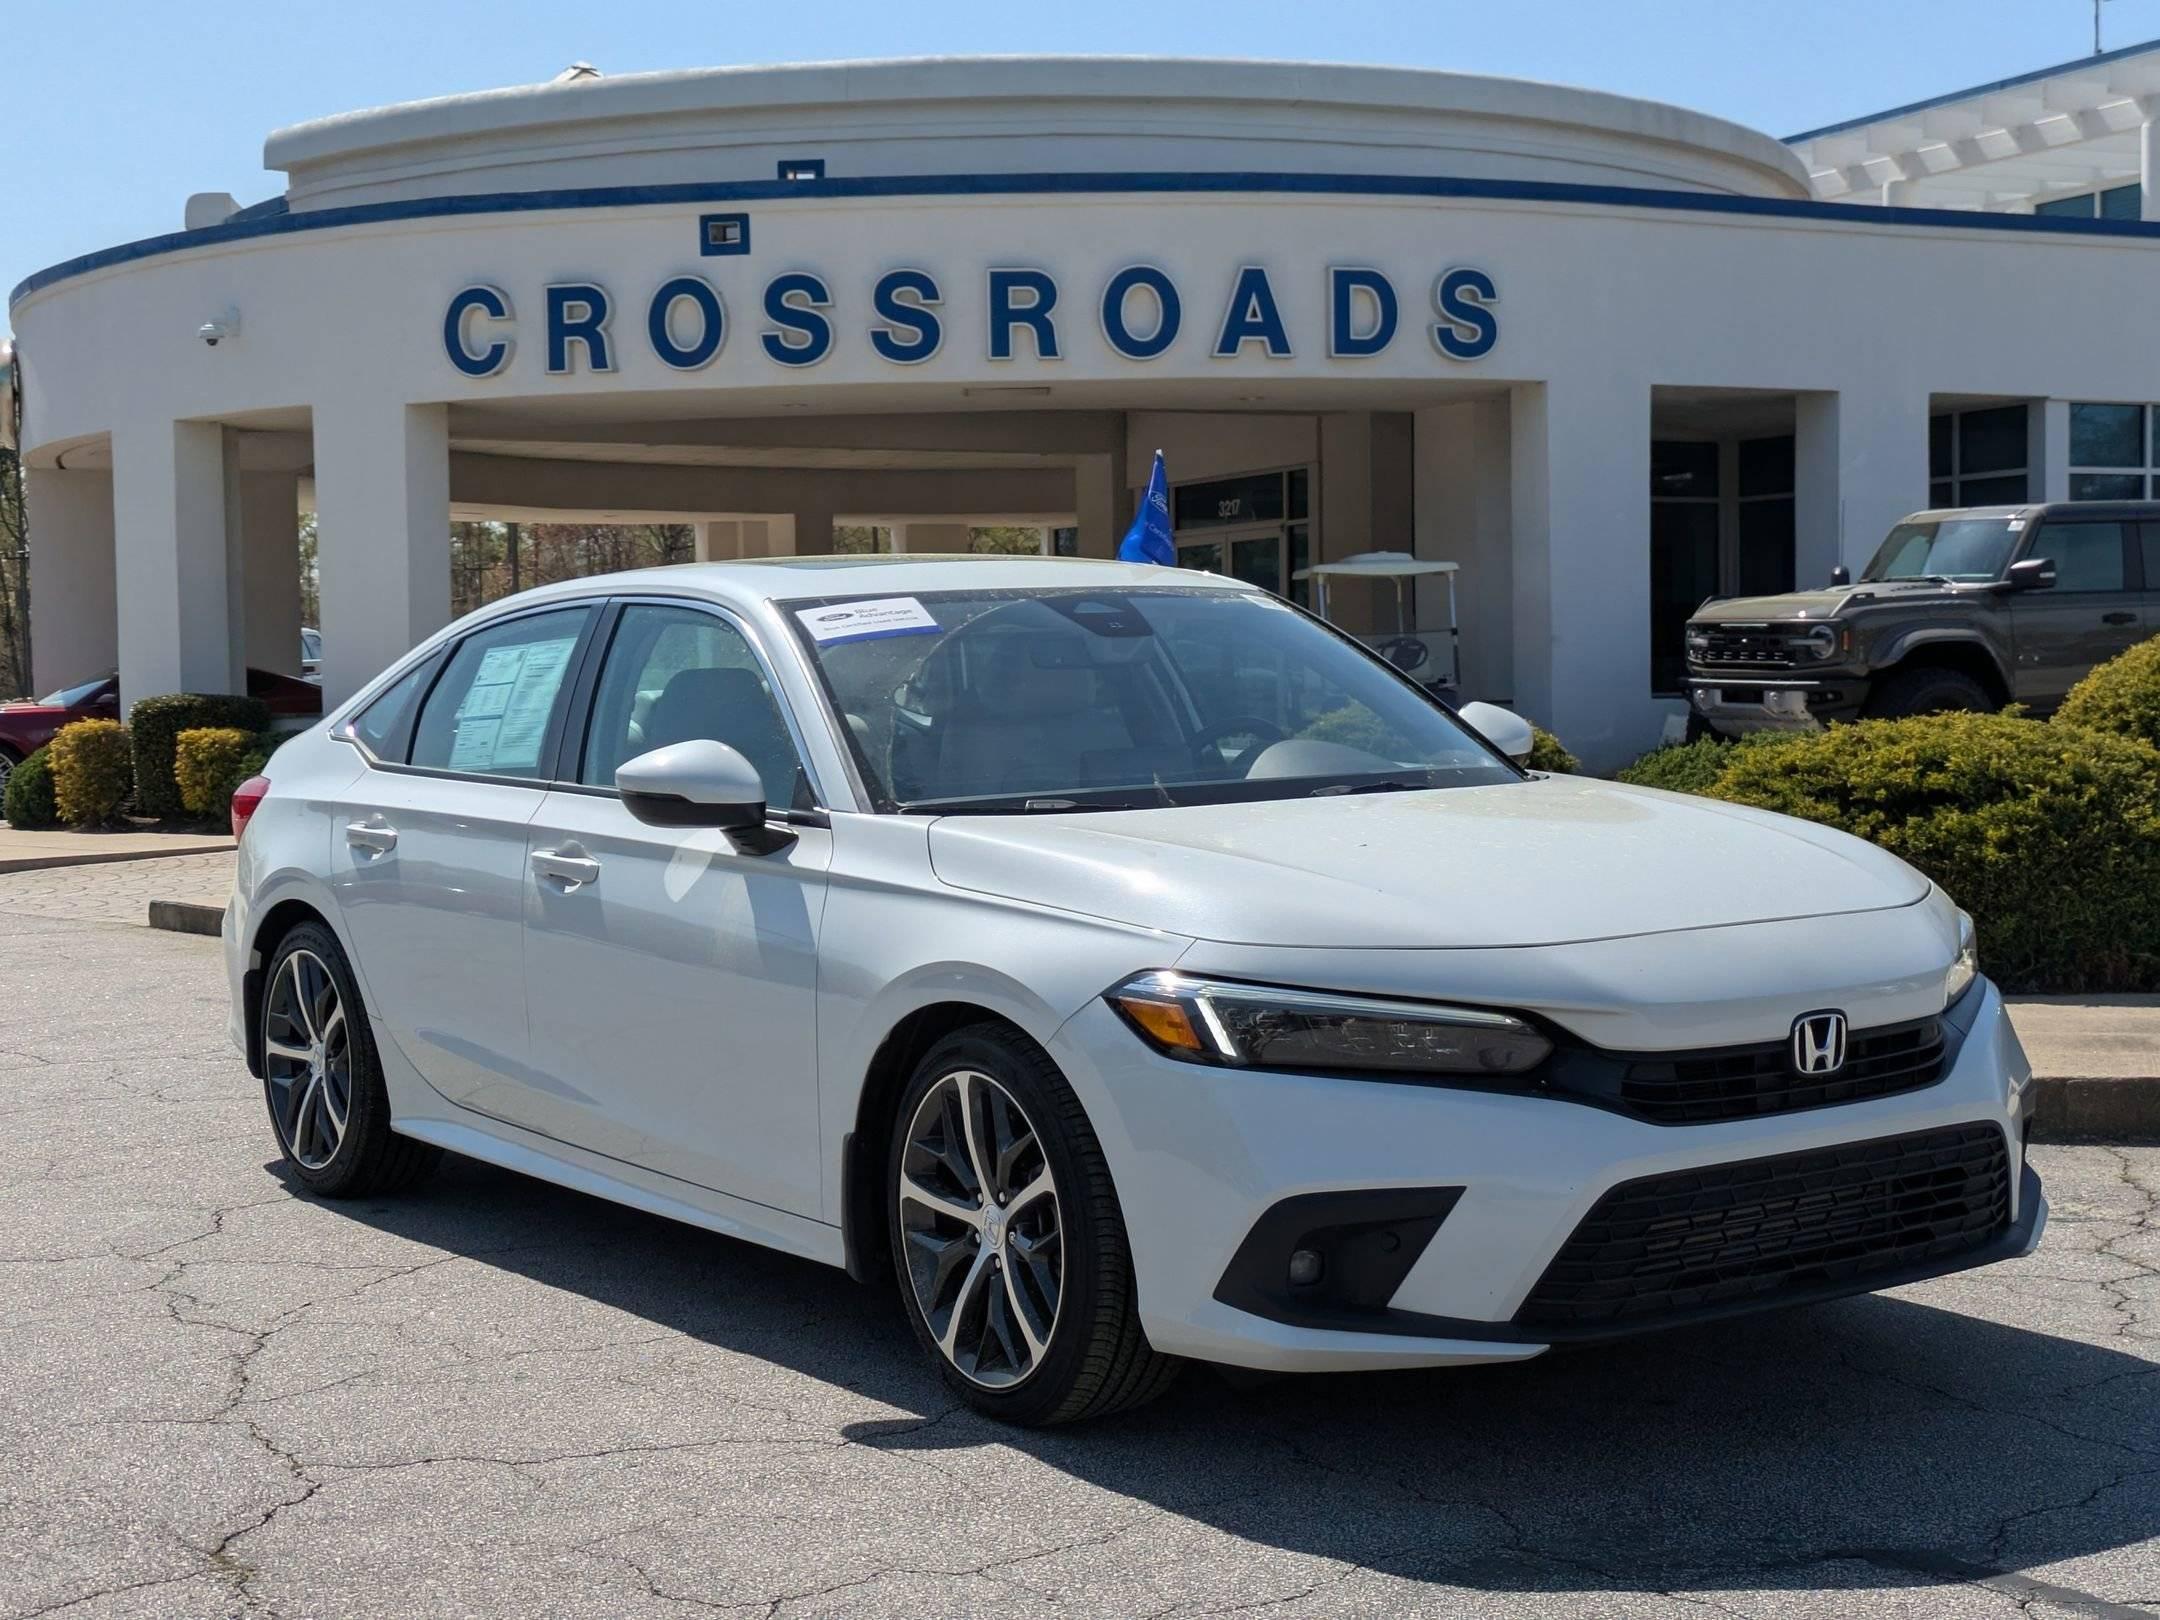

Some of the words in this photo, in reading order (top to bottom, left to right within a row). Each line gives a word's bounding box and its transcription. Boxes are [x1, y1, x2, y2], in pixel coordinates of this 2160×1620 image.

[443, 264, 1499, 379] CROSSROADS
[1218, 499, 1240, 517] 3217
[859, 608, 913, 619] Advantage
